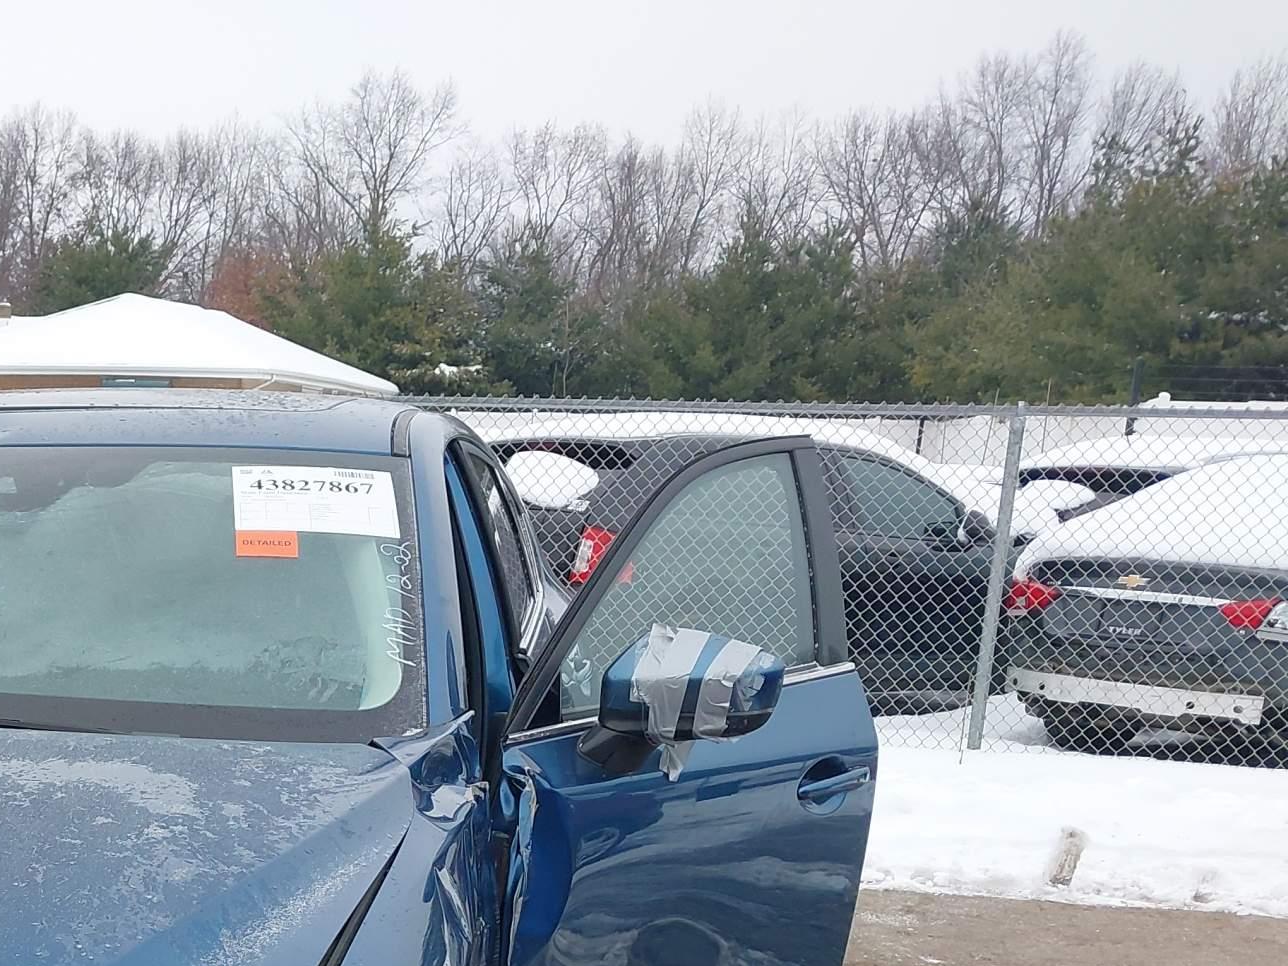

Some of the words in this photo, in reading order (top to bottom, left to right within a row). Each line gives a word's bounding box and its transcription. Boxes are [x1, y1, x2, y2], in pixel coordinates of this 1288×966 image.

[250, 479, 373, 495] 43827867
[242, 539, 292, 547] DETAILED
[1108, 625, 1143, 636] TYLER
